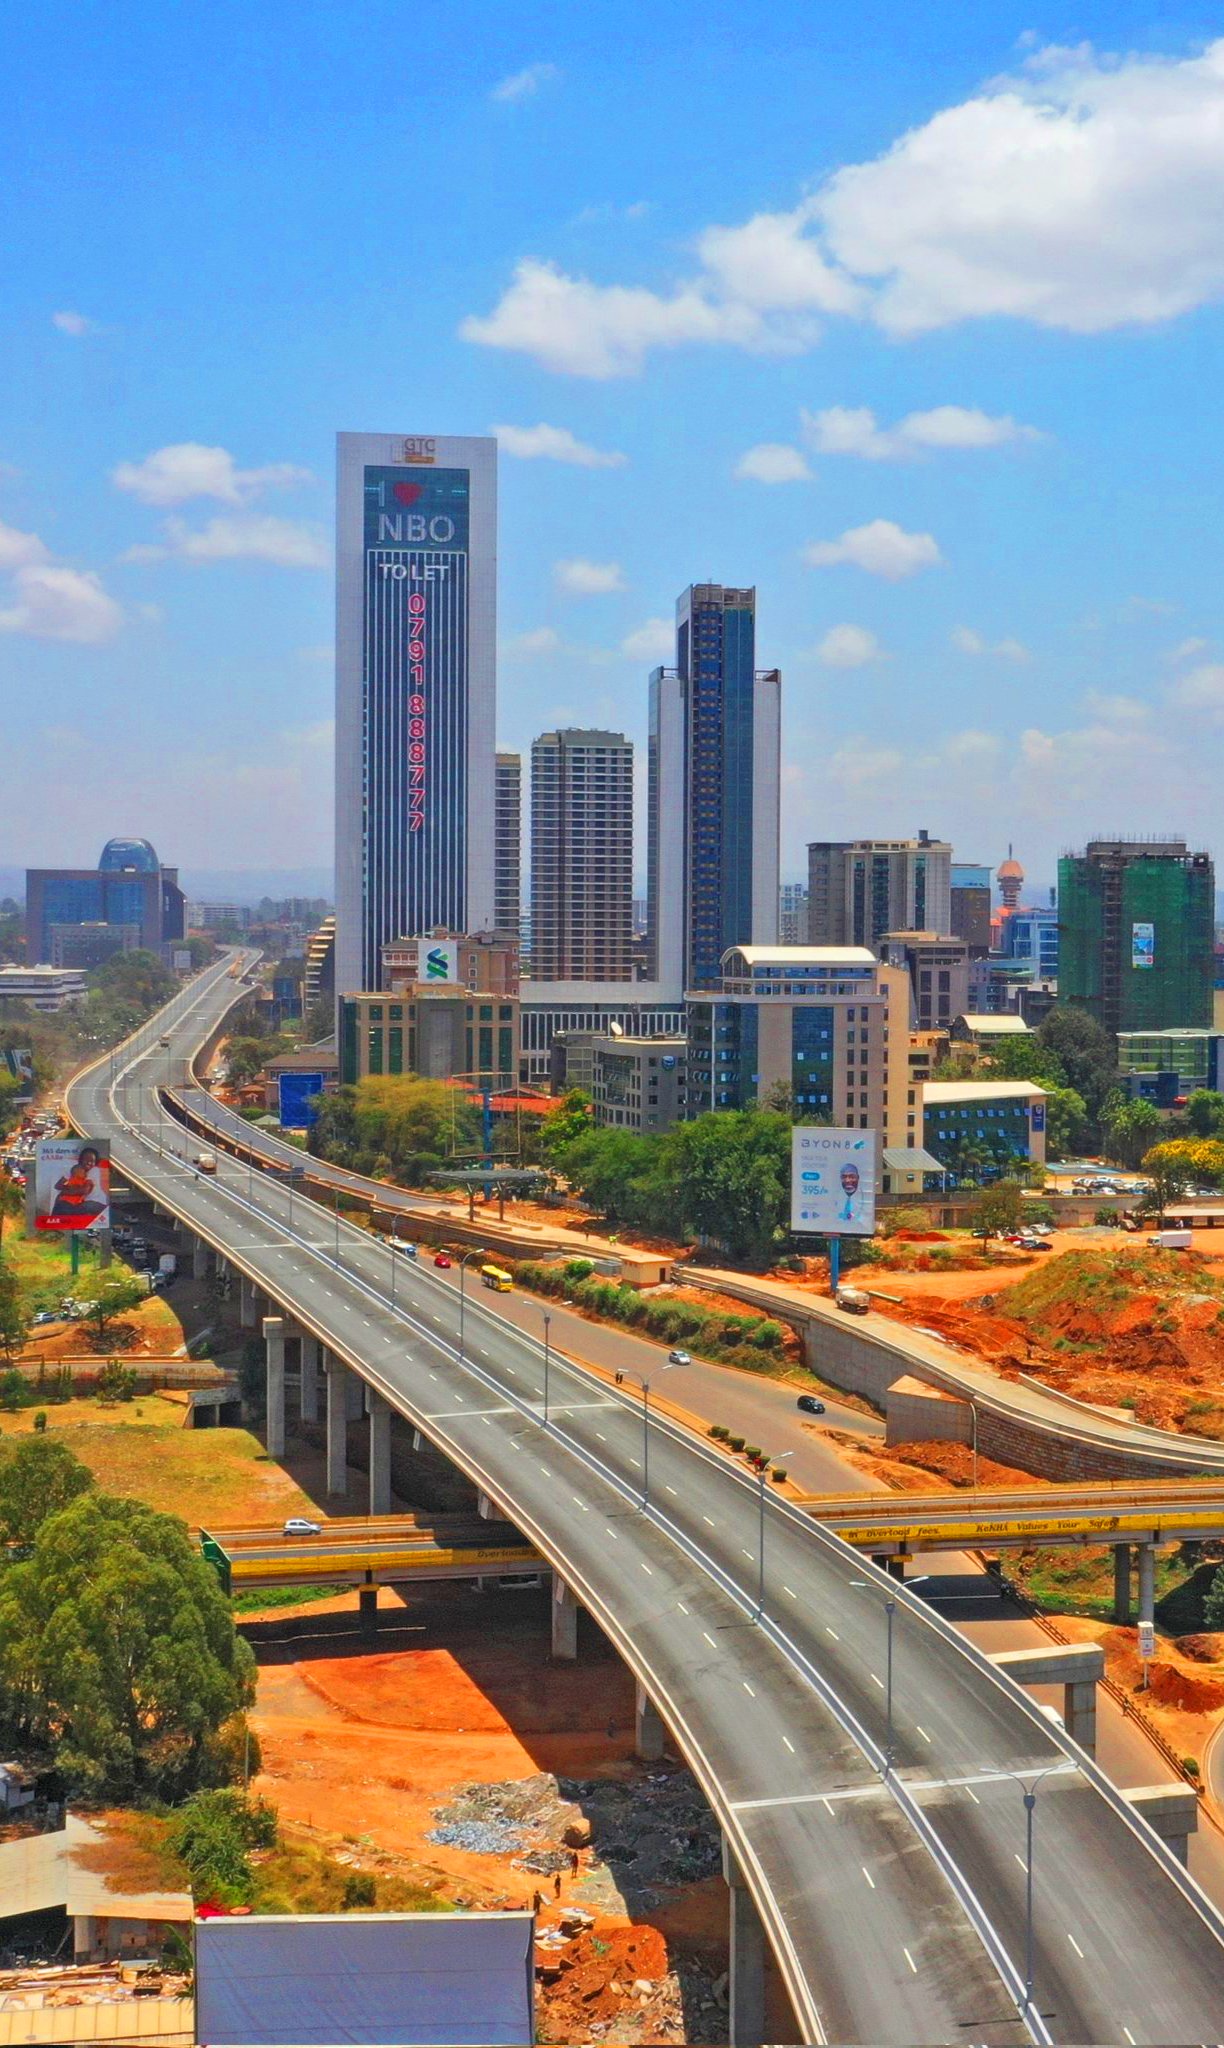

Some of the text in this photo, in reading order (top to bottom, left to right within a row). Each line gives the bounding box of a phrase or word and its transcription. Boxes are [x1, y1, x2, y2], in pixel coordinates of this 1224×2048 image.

[404, 438, 436, 452] GTC
[377, 513, 455, 543] NBO
[410, 564, 449, 581] LET
[1017, 1521, 1049, 1531] Values
[1057, 1519, 1080, 1529] Your
